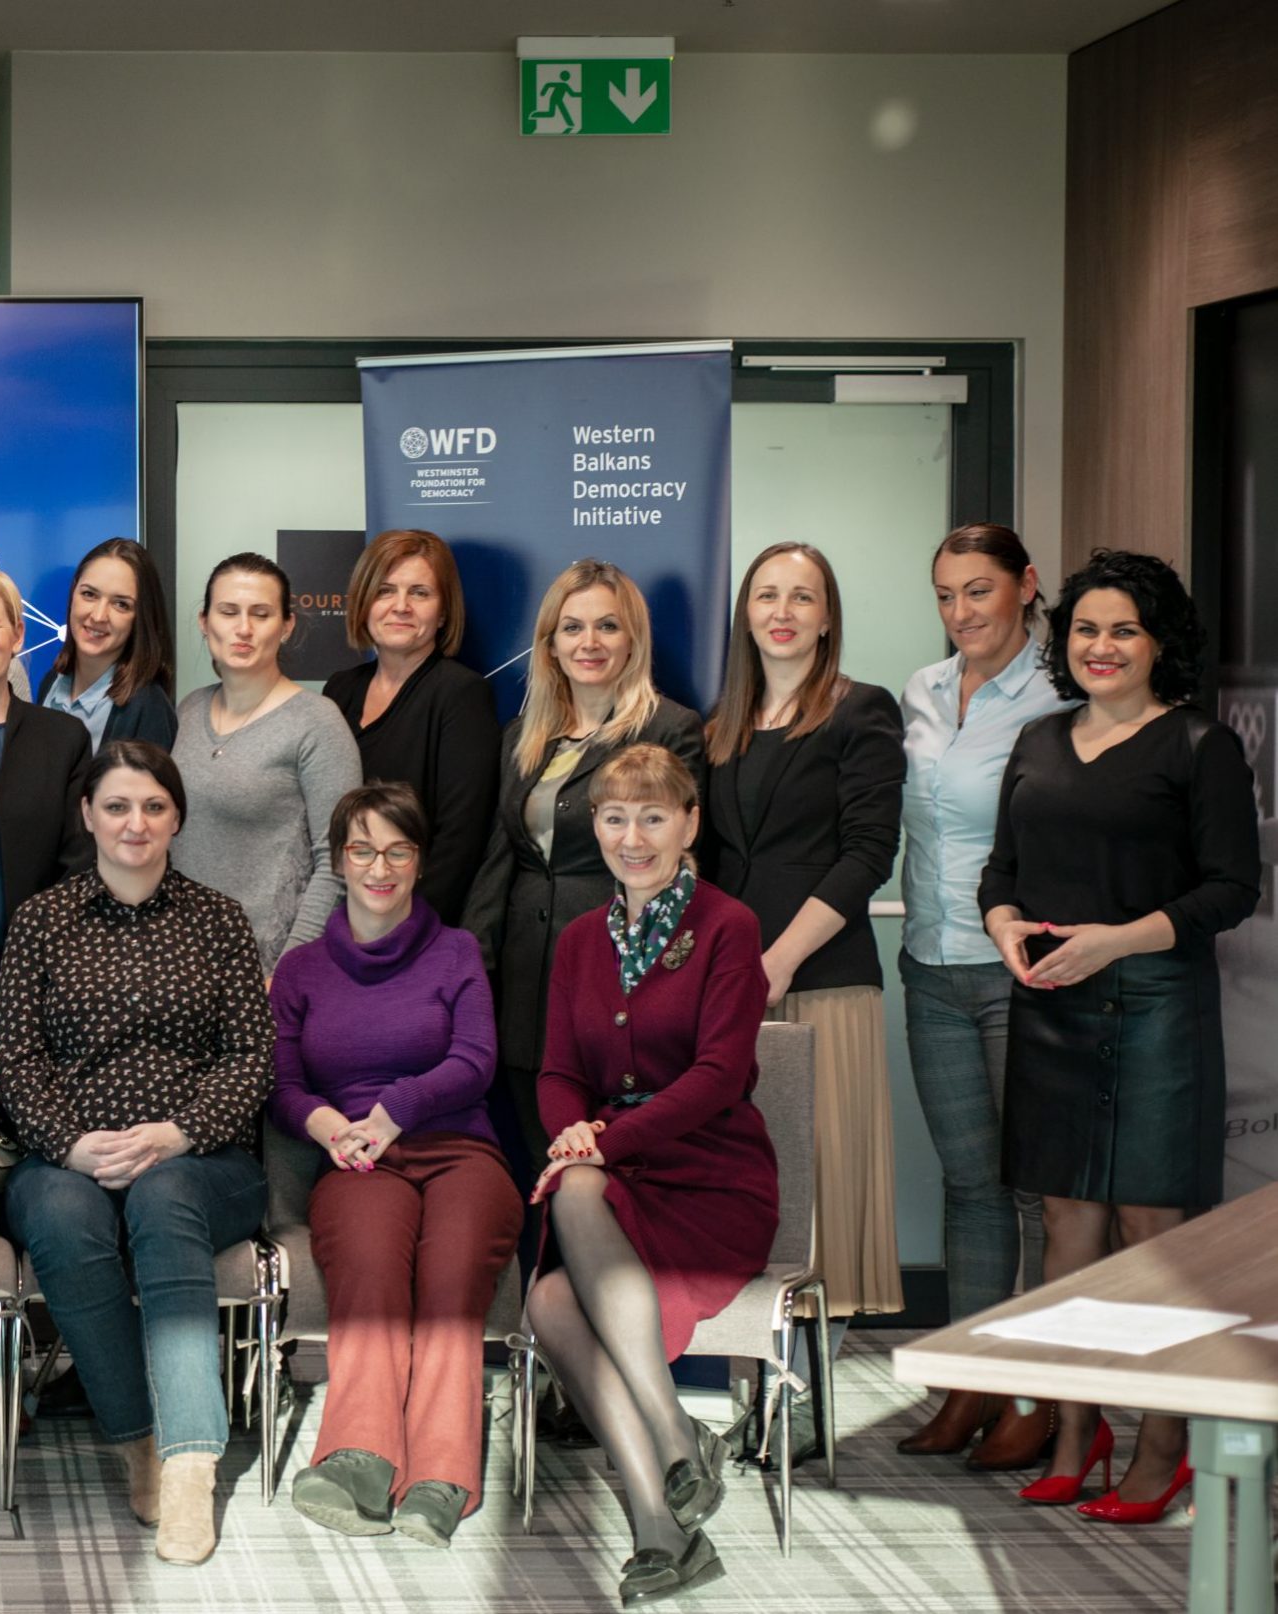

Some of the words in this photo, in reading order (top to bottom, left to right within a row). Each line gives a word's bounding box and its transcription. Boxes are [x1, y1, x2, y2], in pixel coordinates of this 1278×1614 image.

[429, 427, 497, 455] WFD
[572, 424, 655, 445] Western
[572, 452, 652, 472] Balkans
[417, 468, 479, 477] WESTMINSTER
[410, 479, 466, 488] FOUNDATION
[468, 478, 485, 486] FOR
[572, 480, 687, 502] Democracy
[421, 489, 474, 498] DEMOCRACY
[572, 506, 662, 526] Initiative
